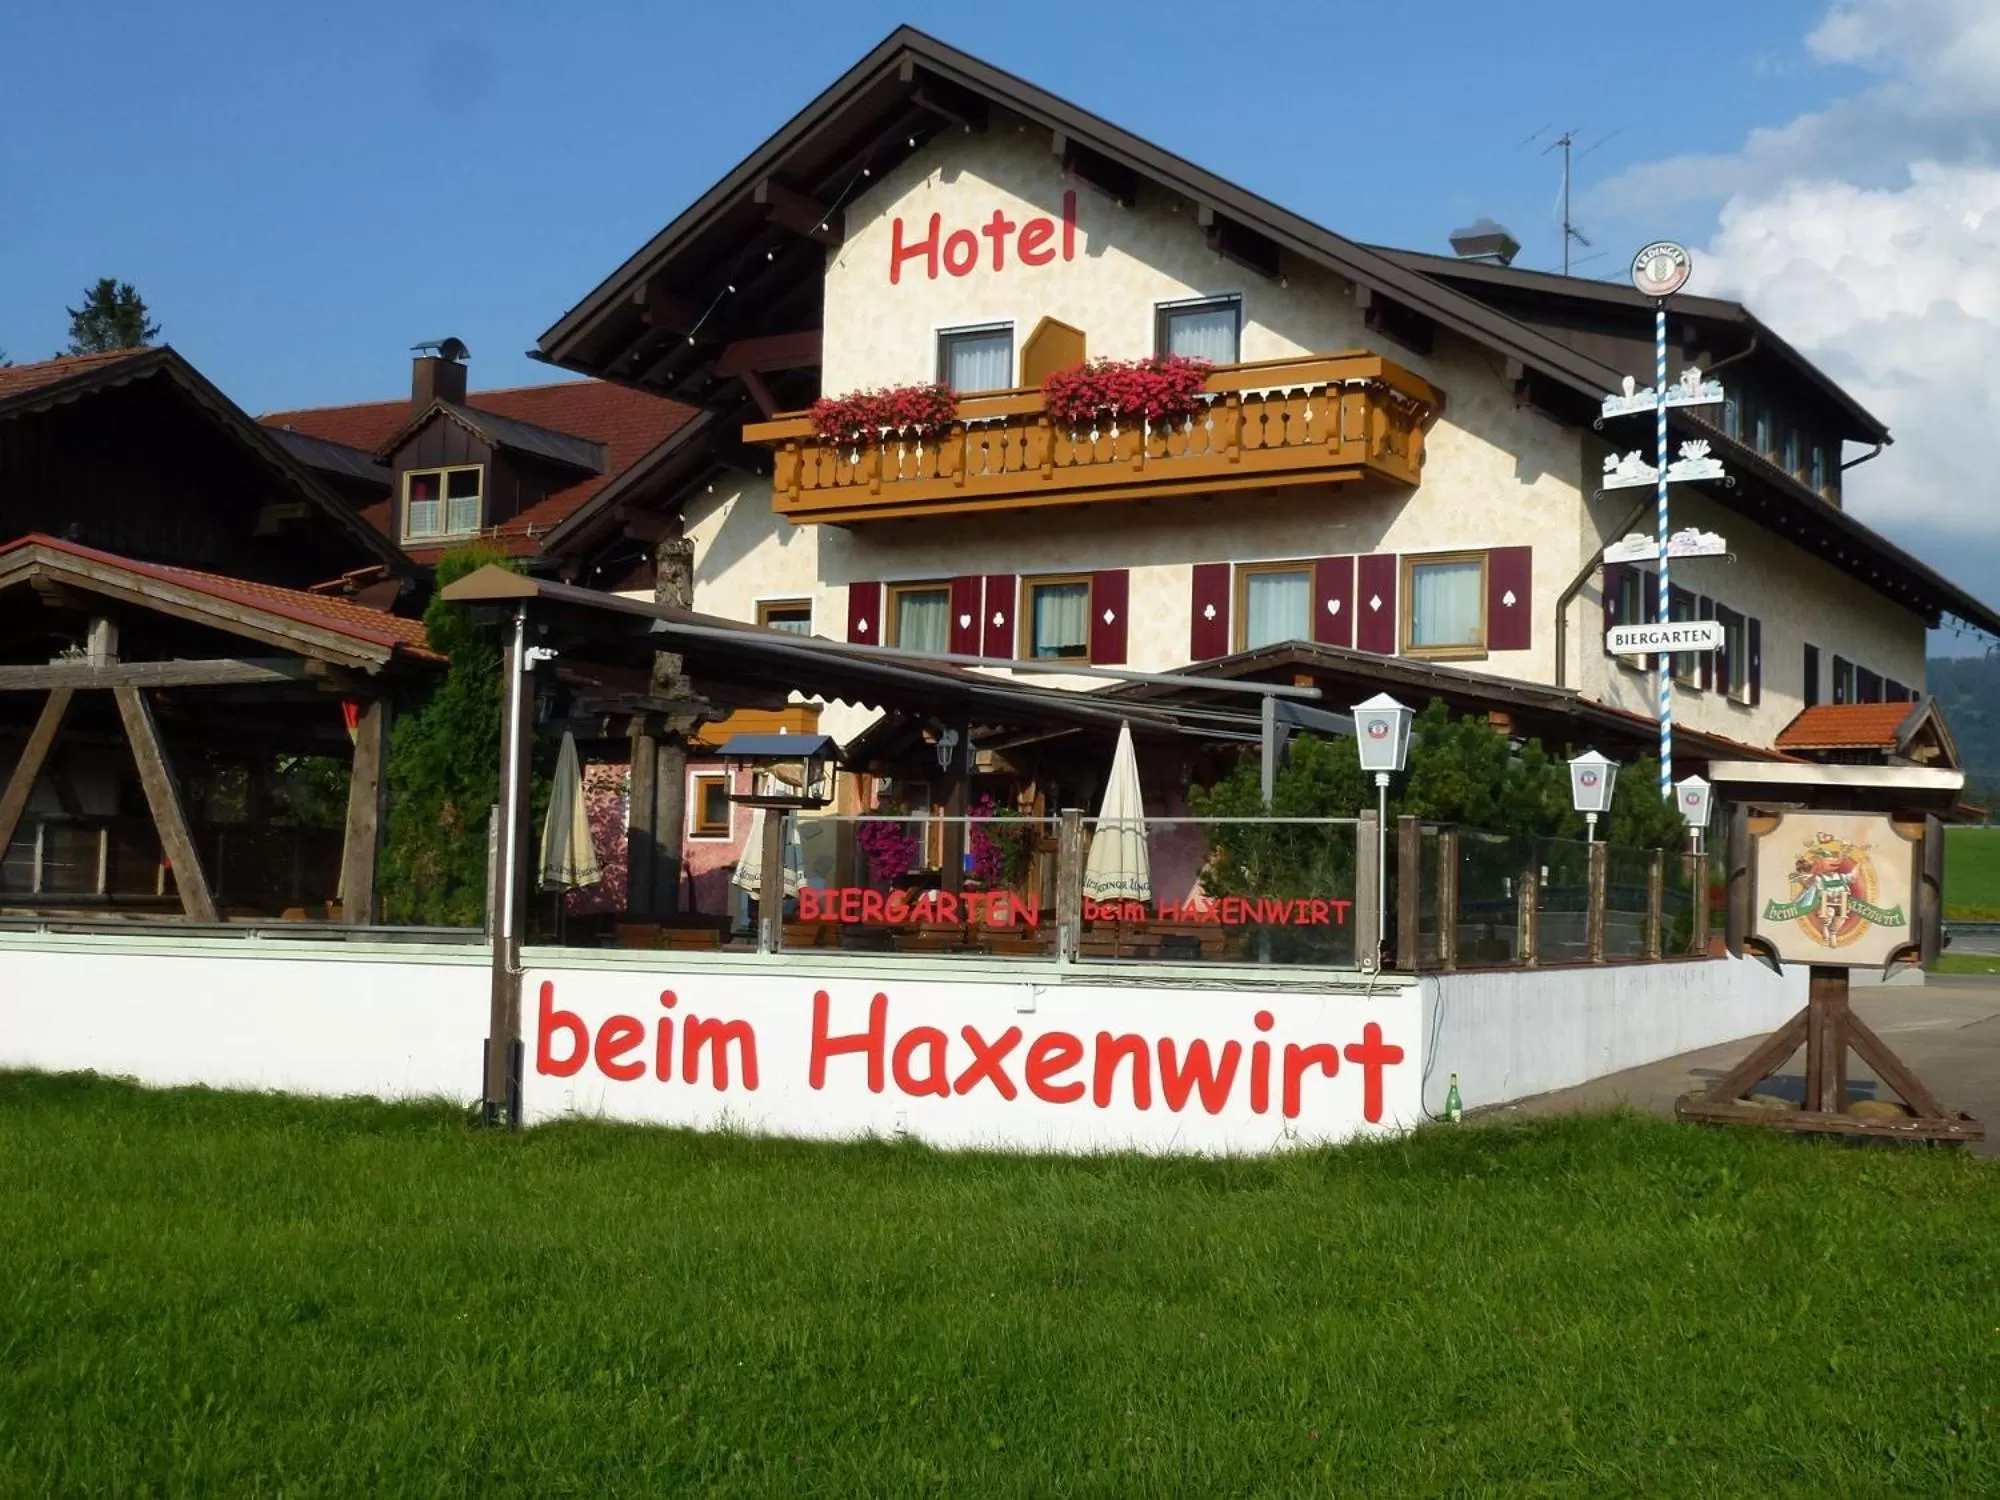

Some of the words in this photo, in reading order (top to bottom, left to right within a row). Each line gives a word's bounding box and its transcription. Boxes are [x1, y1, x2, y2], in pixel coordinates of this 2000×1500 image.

[890, 189, 1077, 285] Hotel
[1615, 629, 1712, 646] BIERGARTEN
[799, 886, 1040, 928] BIERGARTEN
[1083, 897, 1146, 923] beim
[1158, 896, 1352, 926] HAXENWIRT
[536, 980, 760, 1092] beim
[809, 989, 1406, 1124] Haxenwirt
